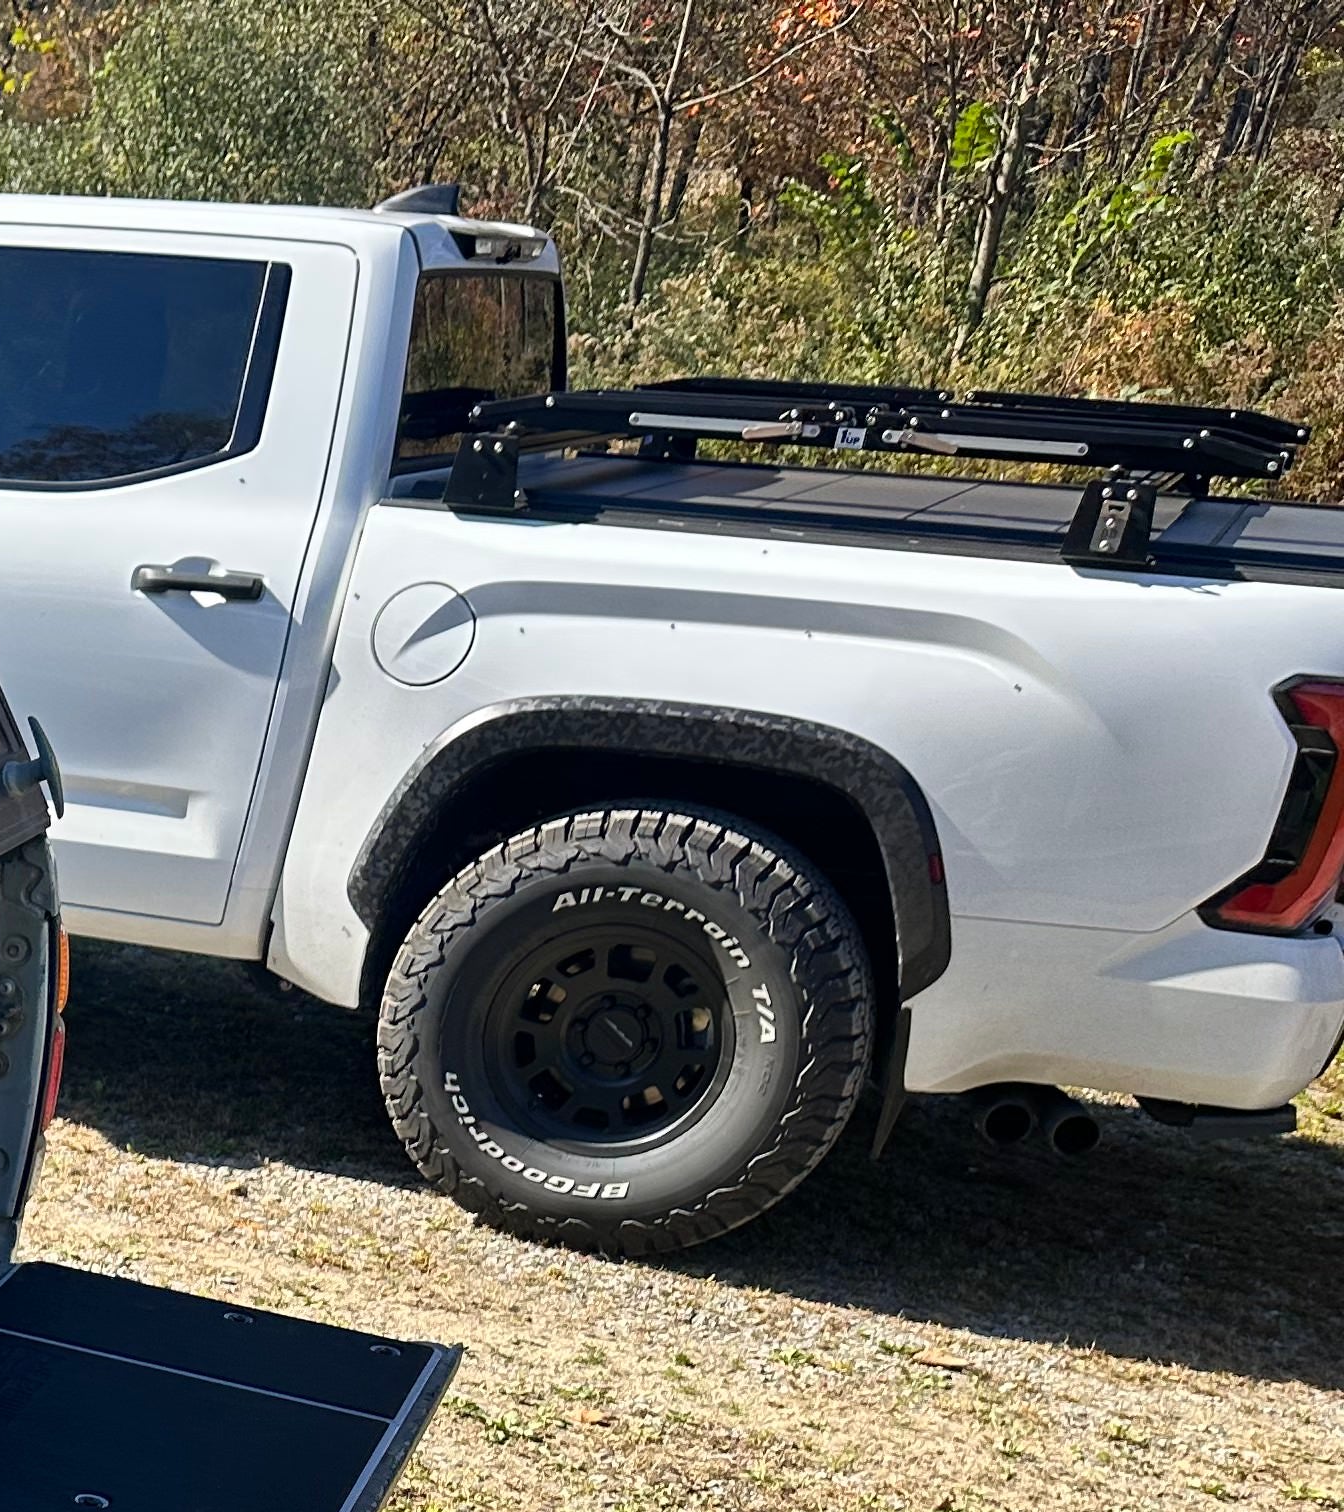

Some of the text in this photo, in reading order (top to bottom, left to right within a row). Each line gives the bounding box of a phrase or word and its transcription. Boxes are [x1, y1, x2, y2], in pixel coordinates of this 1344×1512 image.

[552, 886, 751, 969] All-Terrain
[752, 983, 776, 1043] T/A
[444, 1071, 630, 1199] BFGoodrich
